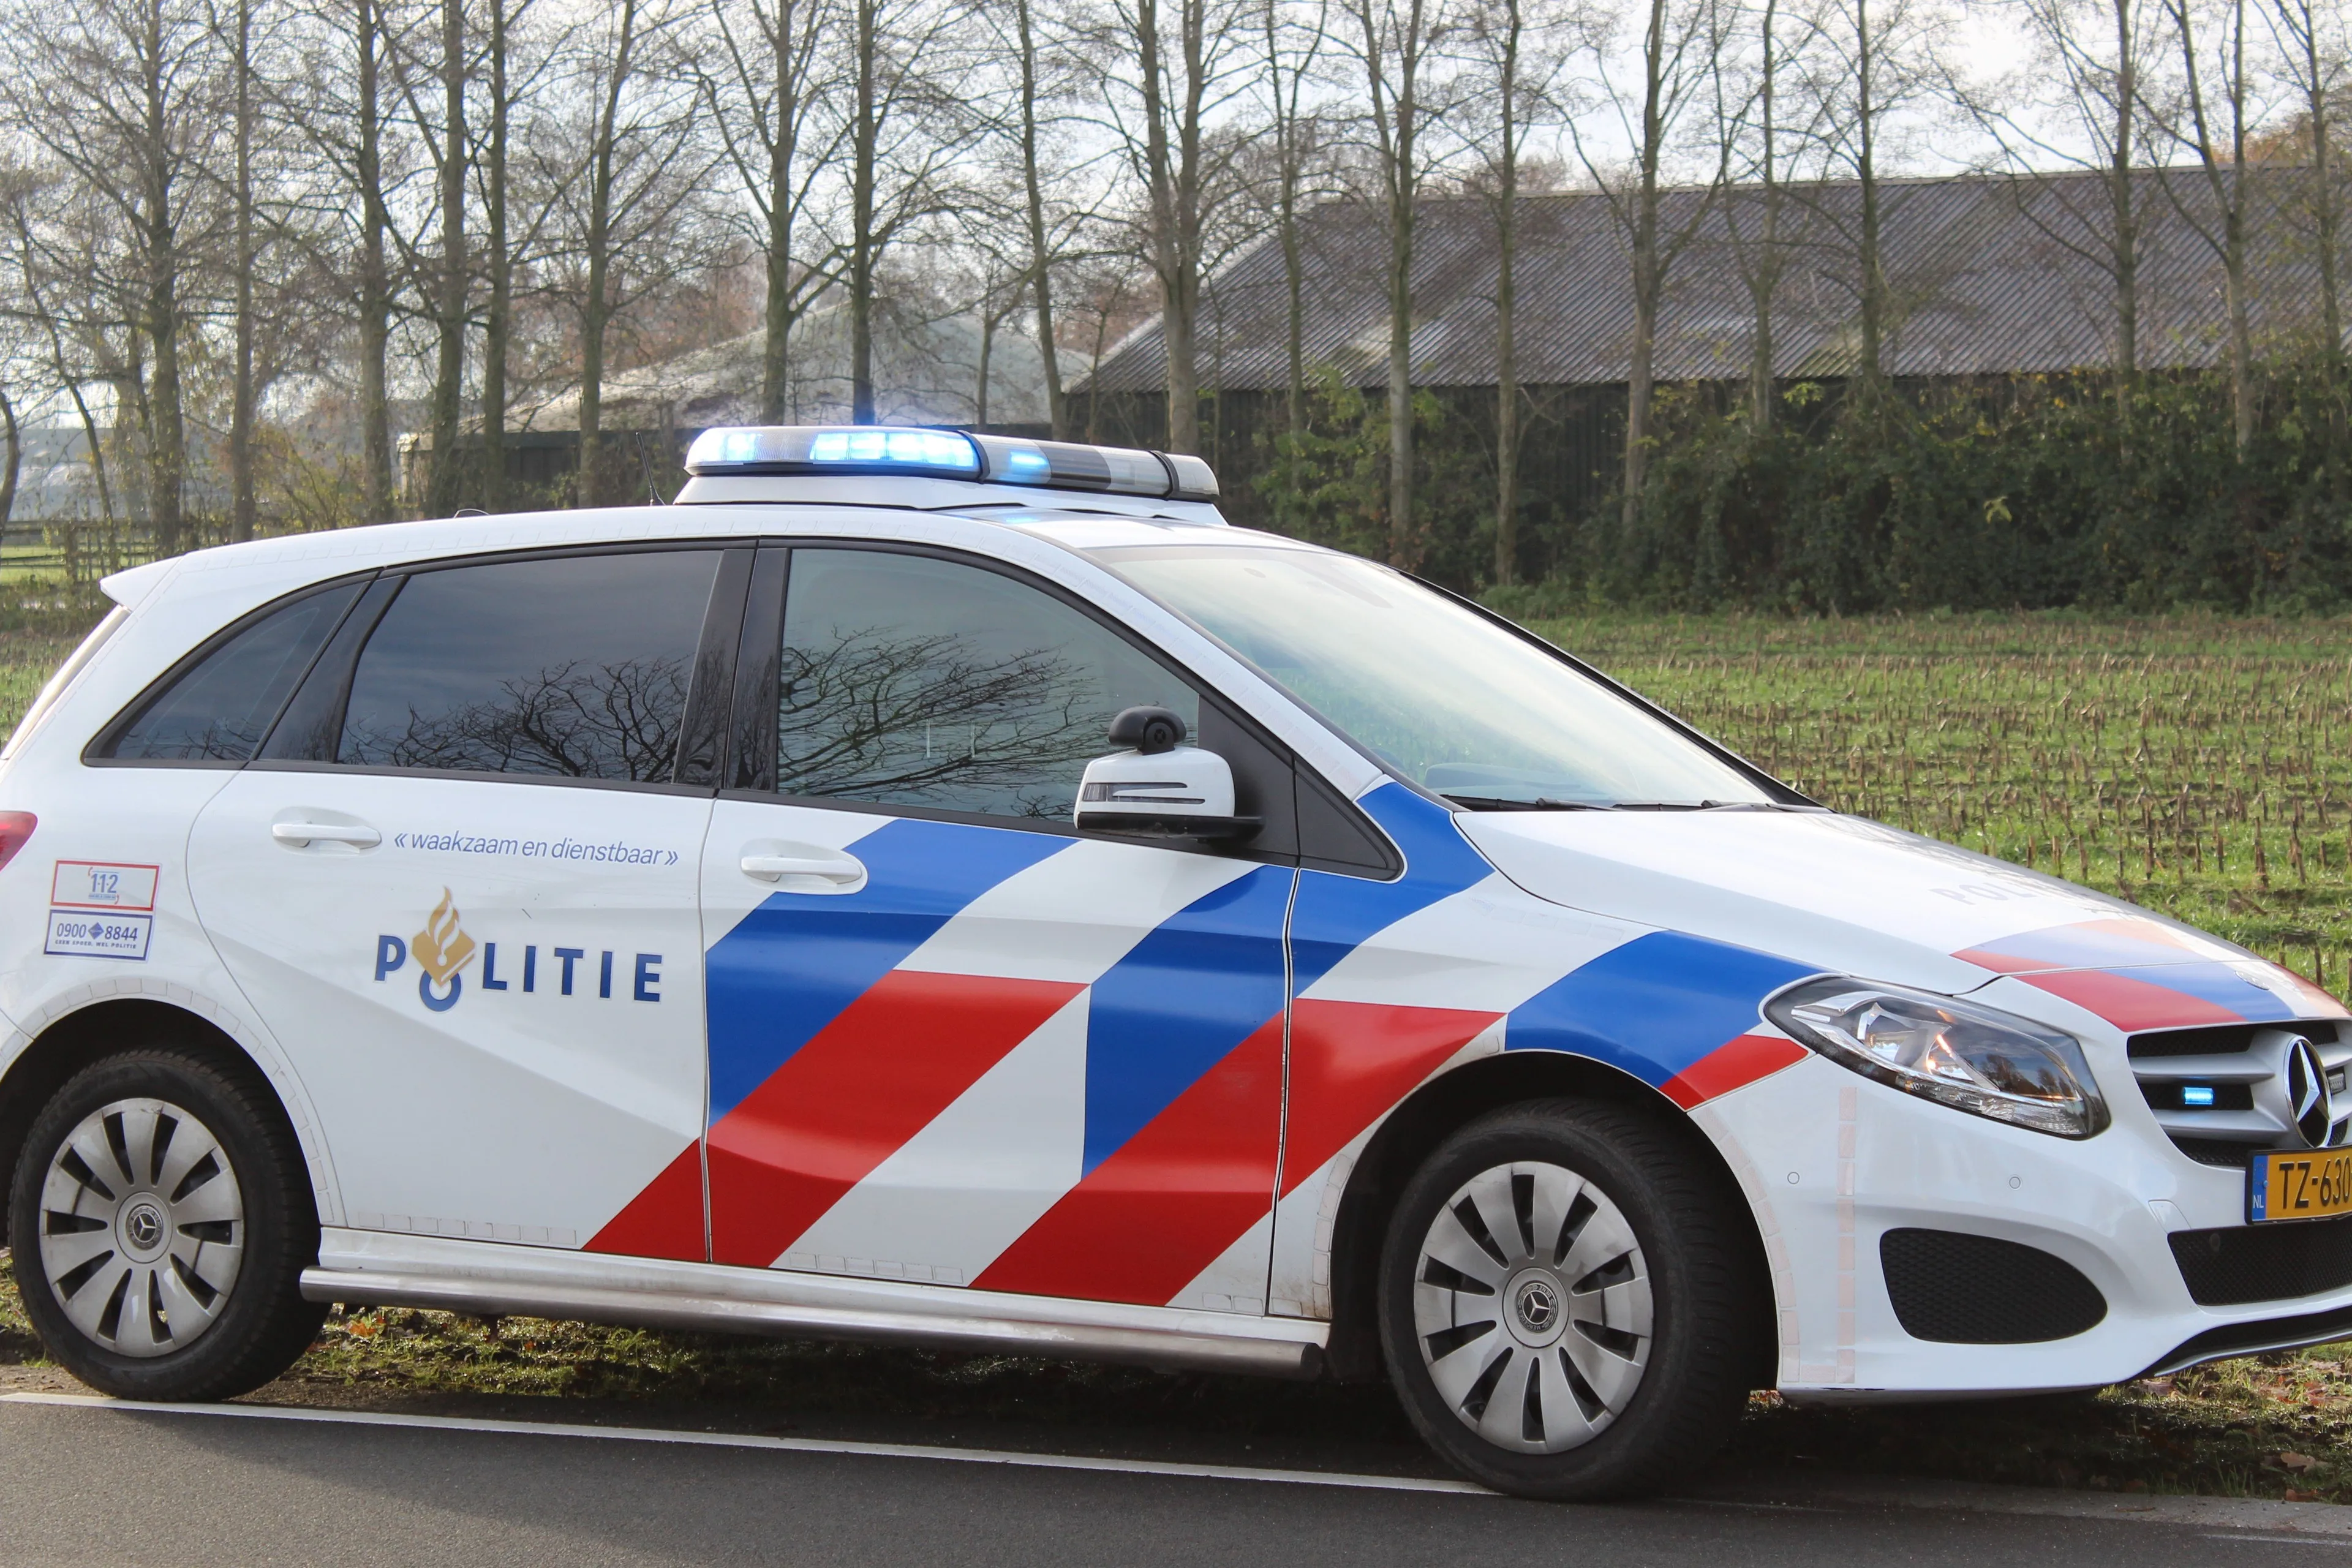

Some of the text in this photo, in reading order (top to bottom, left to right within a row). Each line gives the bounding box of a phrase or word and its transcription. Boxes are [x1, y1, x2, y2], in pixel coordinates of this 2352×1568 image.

[521, 841, 548, 857] en
[56, 922, 138, 941] 0900 8844
[374, 935, 663, 1012] POLITIE
[2278, 1157, 2352, 1209] TZ-630
[2253, 1195, 2264, 1208] NL
